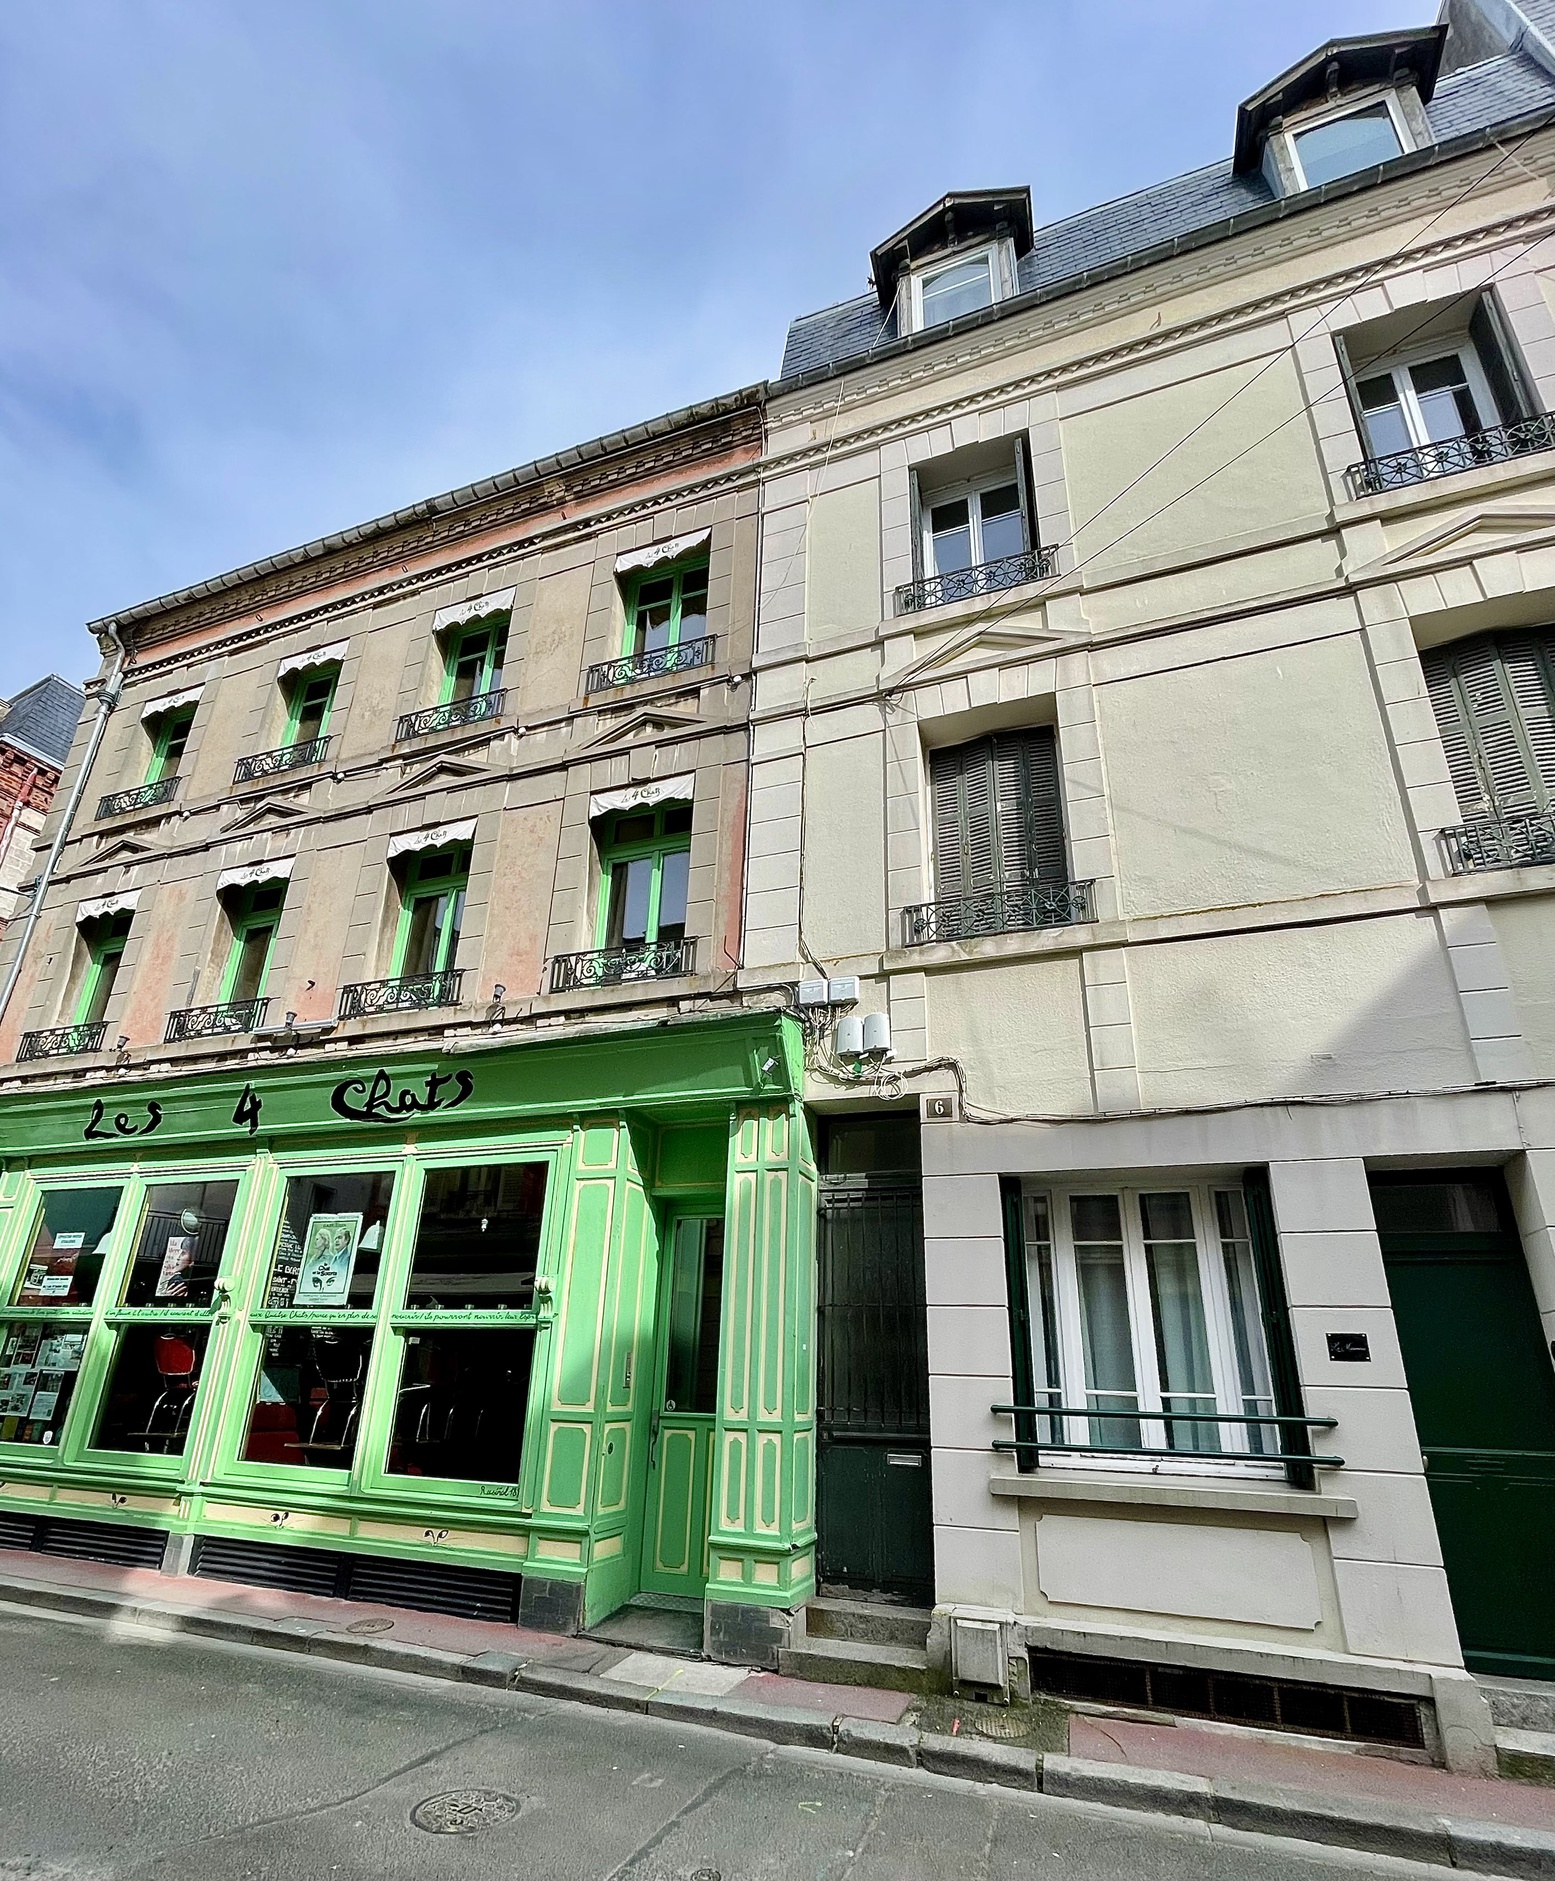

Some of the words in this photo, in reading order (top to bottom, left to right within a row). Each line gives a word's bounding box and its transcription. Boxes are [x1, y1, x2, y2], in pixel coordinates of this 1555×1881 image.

[83, 1098, 163, 1141] Les
[231, 1082, 263, 1136] 4
[330, 1068, 475, 1123] Chats
[934, 1099, 945, 1115] 6
